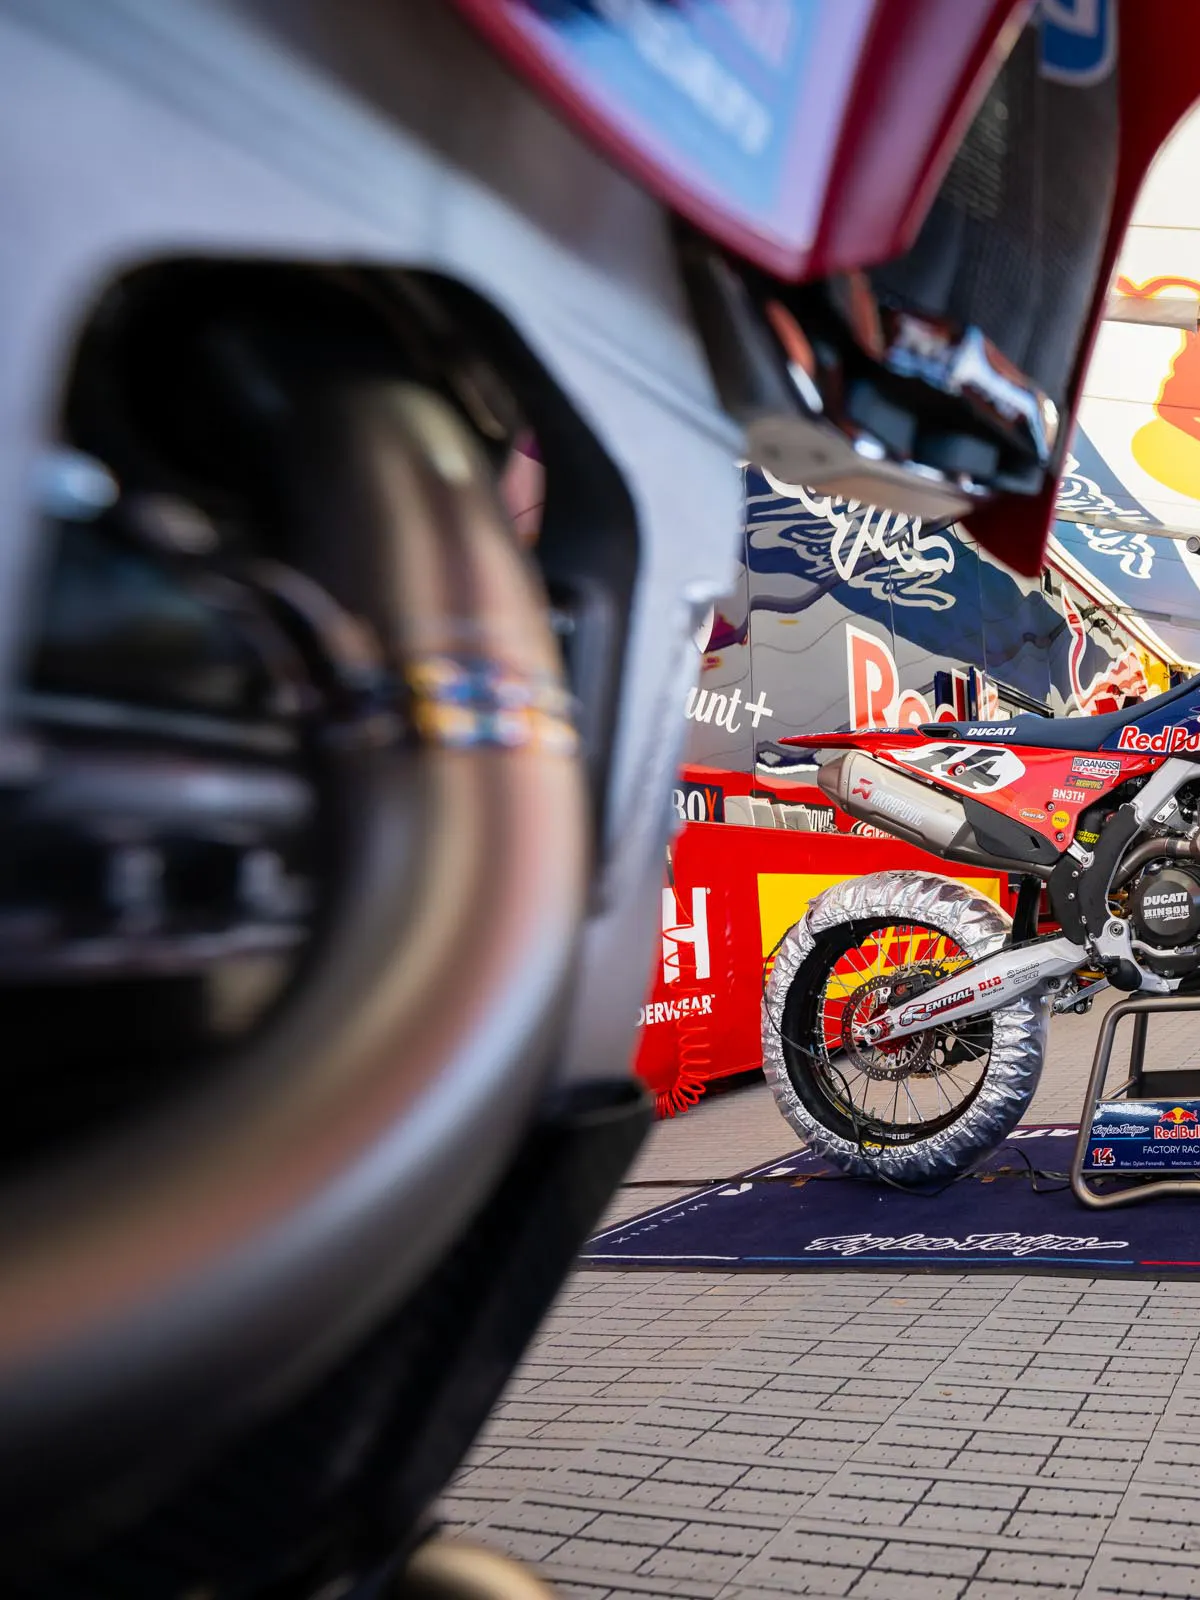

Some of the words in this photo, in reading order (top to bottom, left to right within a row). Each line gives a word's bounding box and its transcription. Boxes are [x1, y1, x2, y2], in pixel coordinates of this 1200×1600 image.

[966, 727, 1017, 737] DUCATI
[1117, 725, 1171, 752] Red
[1072, 766, 1119, 776] RACING
[1082, 759, 1120, 770] GANASSI
[1053, 788, 1085, 801] BN3TH
[1143, 891, 1188, 907] DUCATI
[1143, 904, 1190, 918] HINSON
[1092, 1124, 1108, 1138] Troy
[1119, 1123, 1150, 1138] Designs
[1154, 1124, 1179, 1139] Red
[1092, 1147, 1116, 1166] 14
[1142, 1145, 1180, 1154] FACTORY
